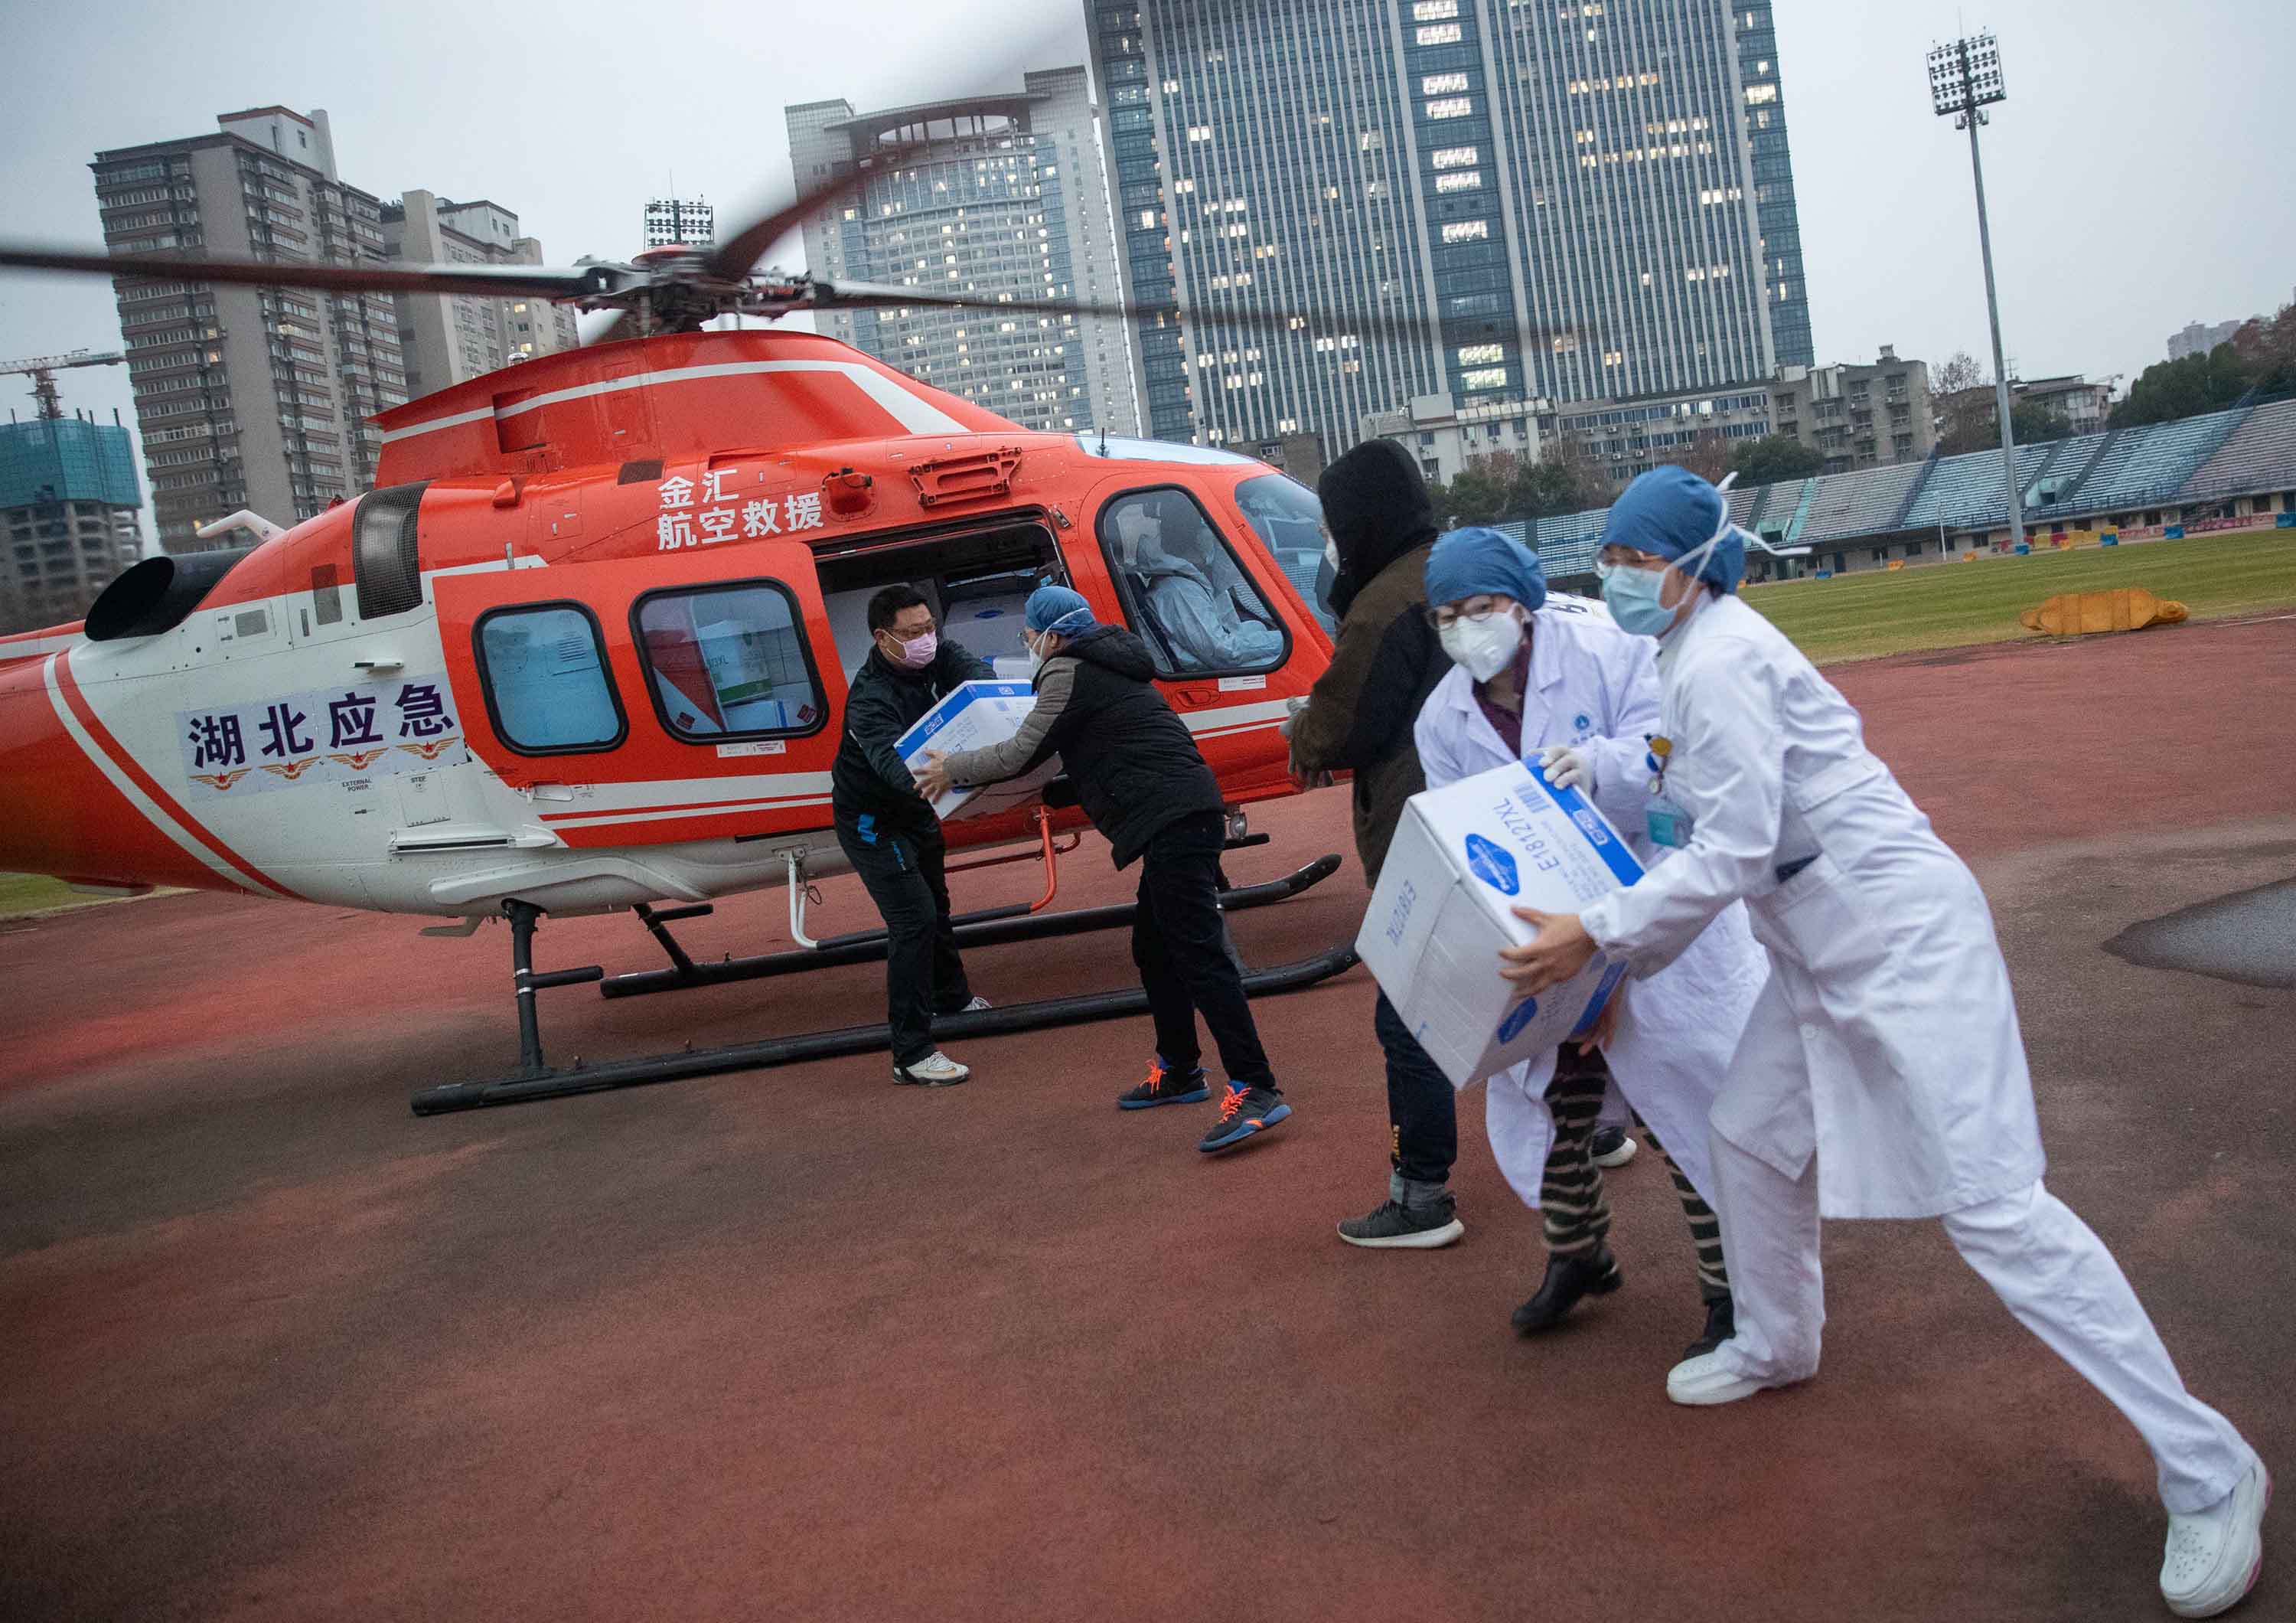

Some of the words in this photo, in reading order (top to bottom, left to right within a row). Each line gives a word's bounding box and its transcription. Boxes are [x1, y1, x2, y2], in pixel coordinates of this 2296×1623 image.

[658, 469, 740, 510] 金汇
[657, 492, 824, 550] 航空救援
[188, 684, 455, 769] 湖北应急
[342, 778, 372, 787] EXTERNAL
[1493, 798, 1560, 872] E18127XL
